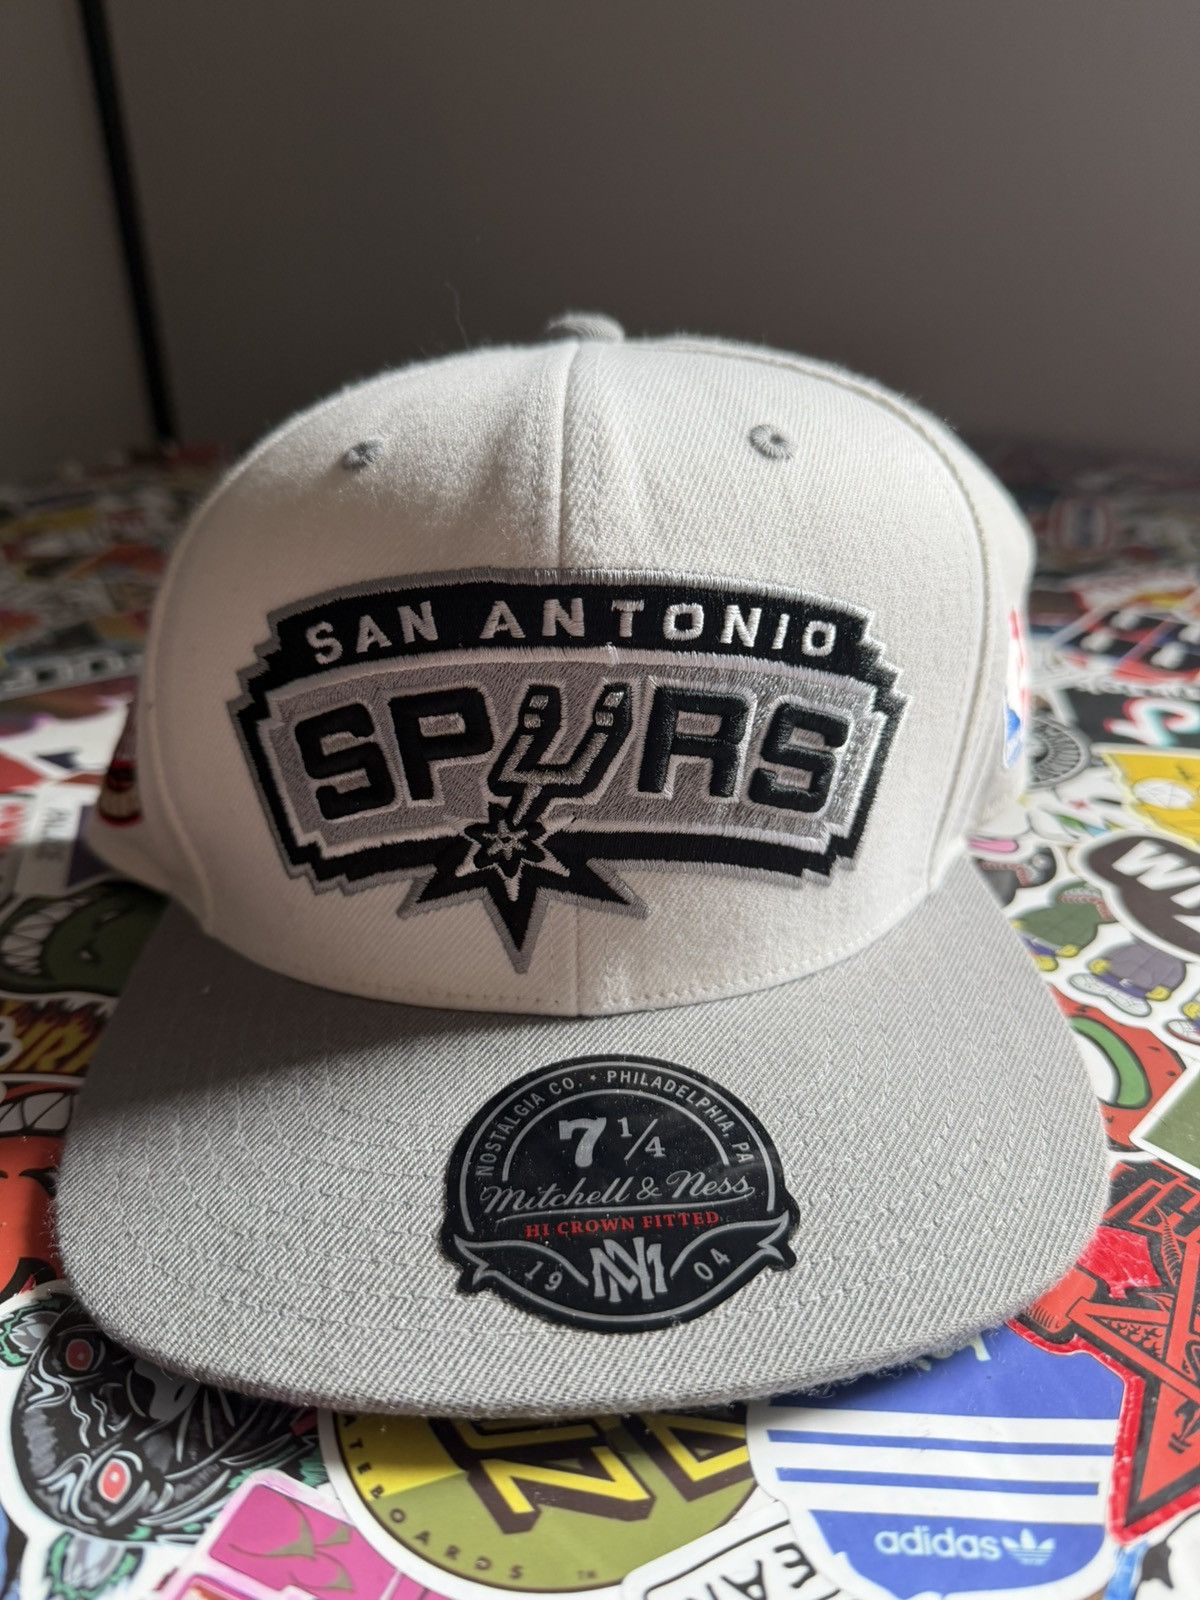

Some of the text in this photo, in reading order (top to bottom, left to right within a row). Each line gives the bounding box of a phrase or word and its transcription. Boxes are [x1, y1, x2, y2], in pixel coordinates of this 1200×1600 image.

[305, 597, 837, 665] SAN ANTONIO
[293, 683, 851, 822] SPURS
[475, 1070, 755, 1178] NOSTALGIA CO. PHILADELPHIA, PA
[558, 1117, 607, 1168] 7
[480, 1169, 755, 1214] Mitchell & Ness
[524, 1210, 720, 1239] HI CROWN FITTED
[873, 1525, 1002, 1562] adidas
